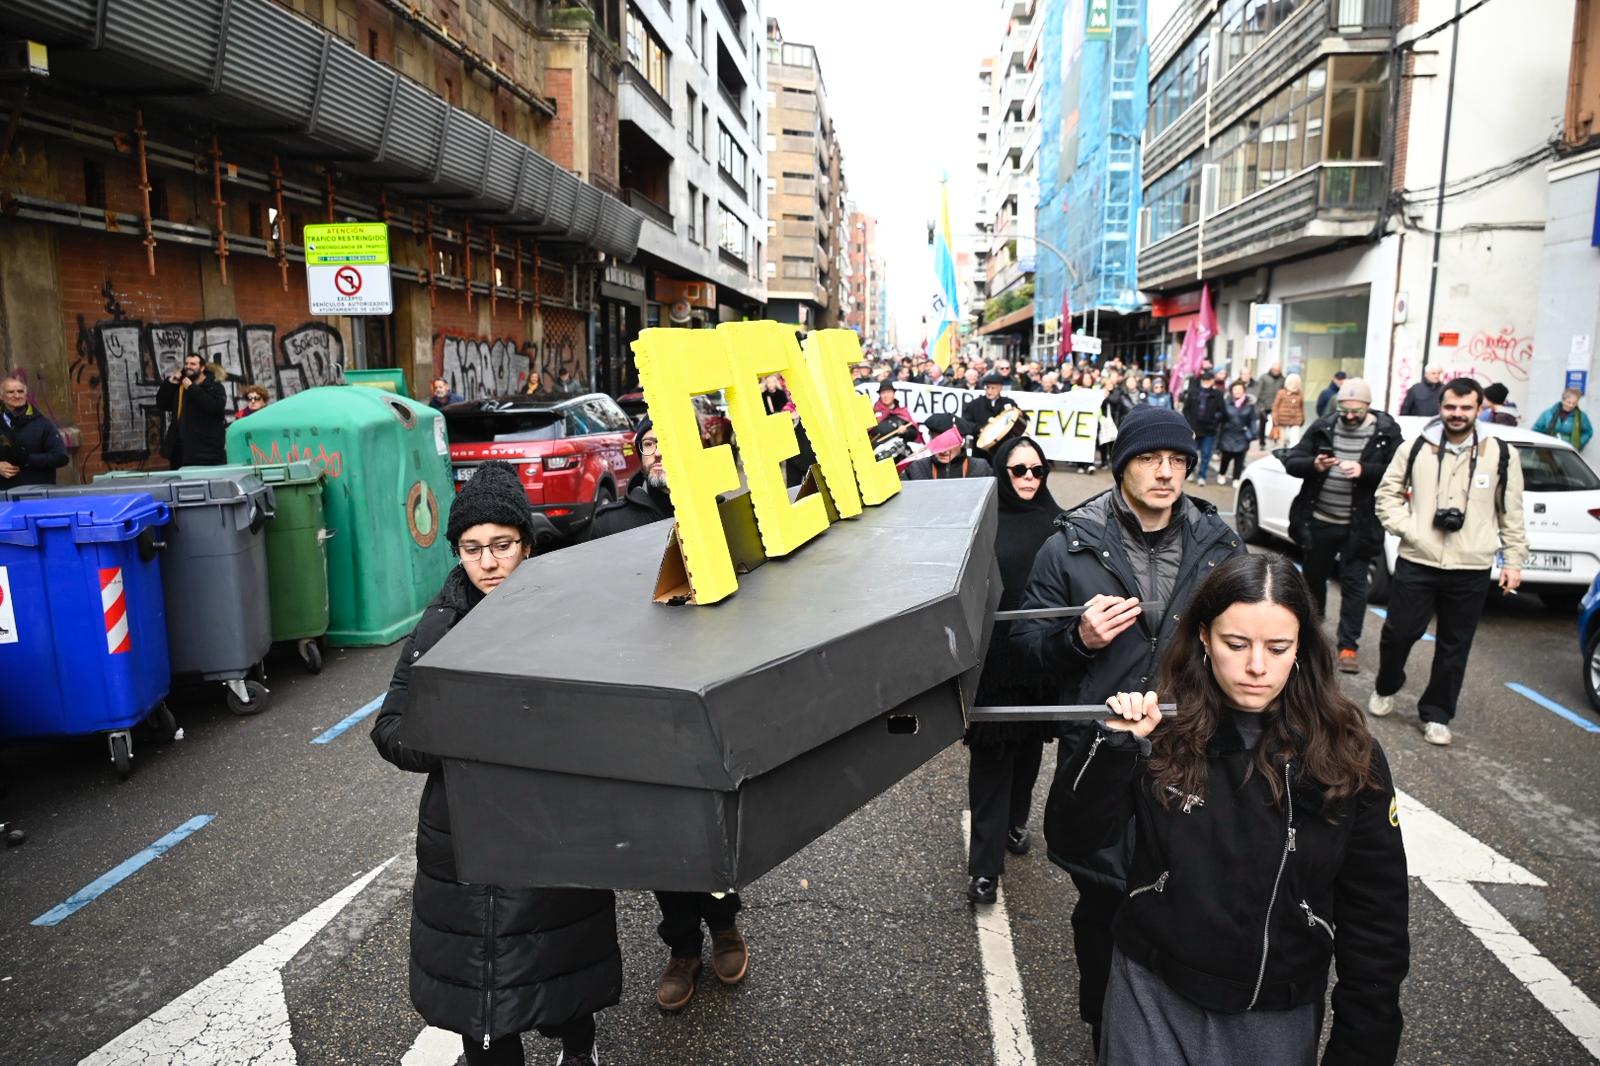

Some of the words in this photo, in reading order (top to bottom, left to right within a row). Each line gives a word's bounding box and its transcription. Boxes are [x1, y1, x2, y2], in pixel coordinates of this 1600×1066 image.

[451, 450, 475, 458] NGE
[481, 447, 525, 457] ROVER
[630, 320, 902, 606] FEVE
